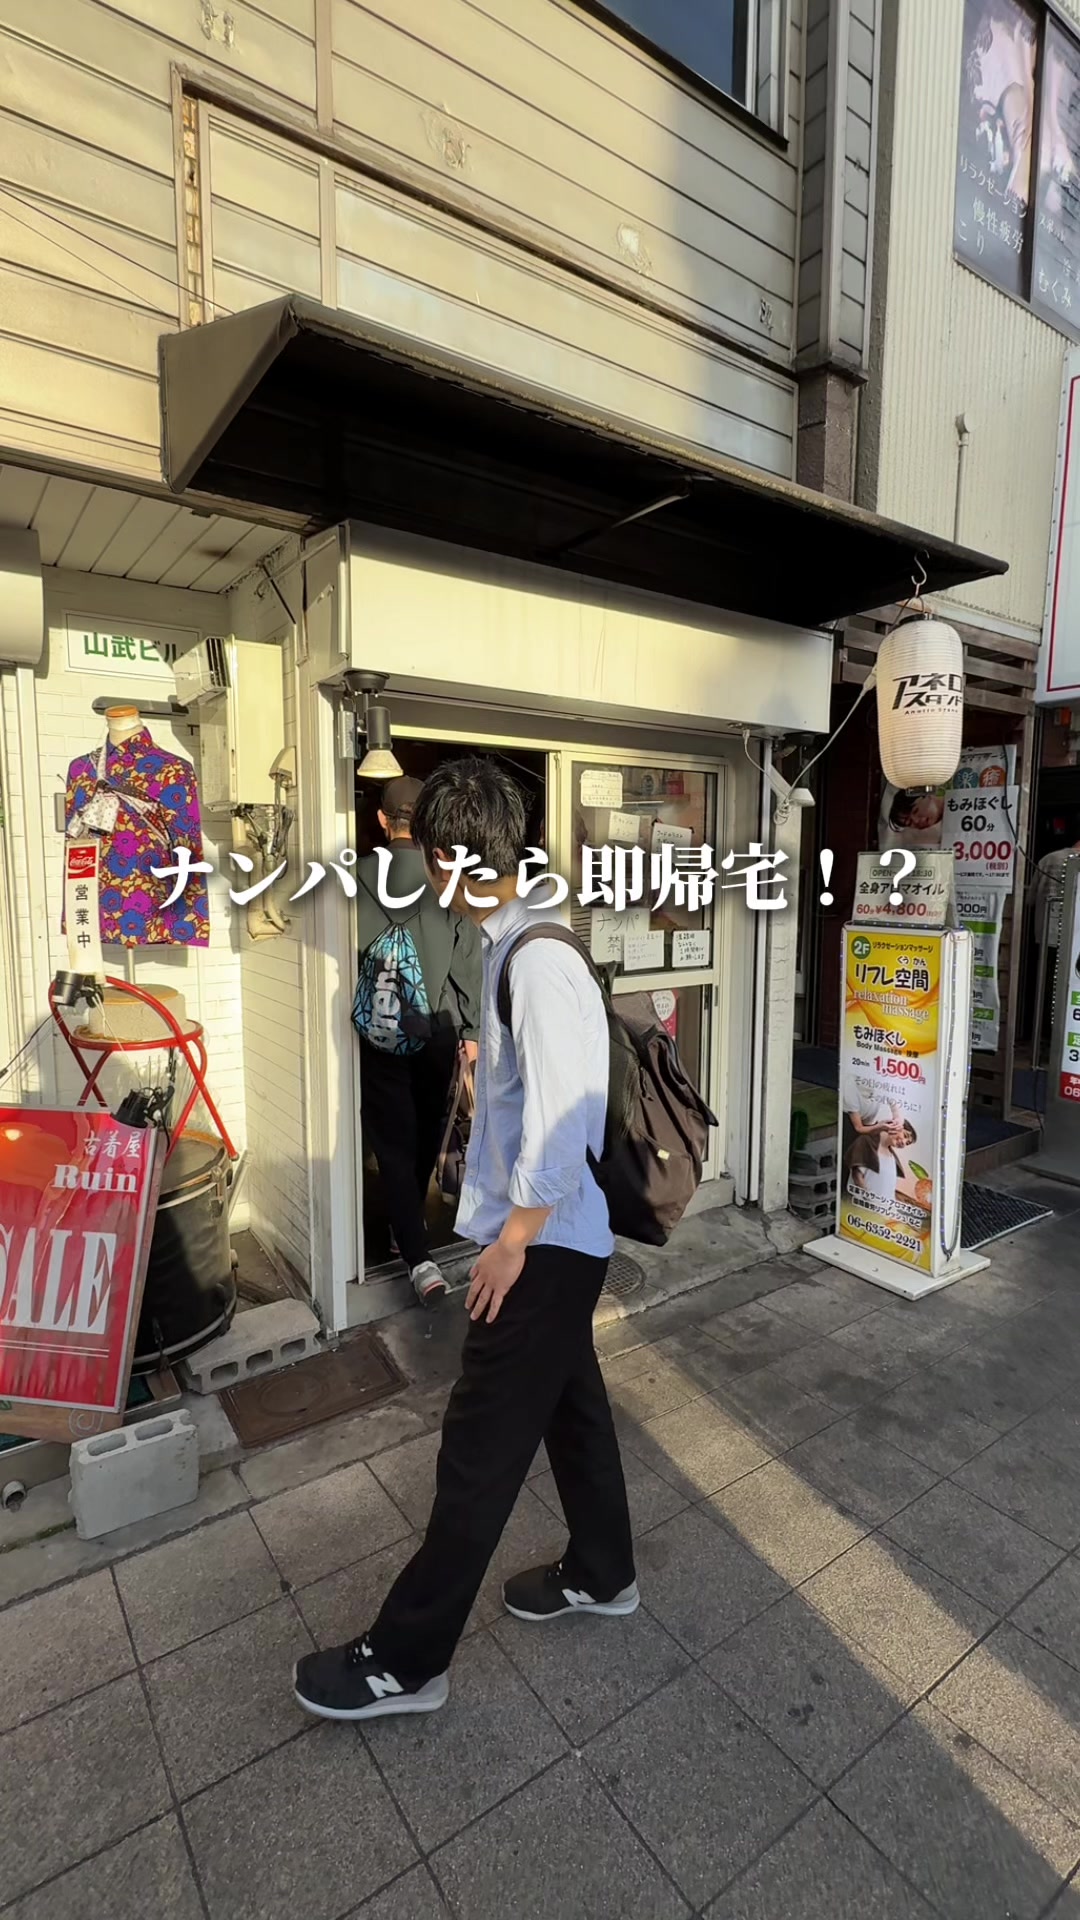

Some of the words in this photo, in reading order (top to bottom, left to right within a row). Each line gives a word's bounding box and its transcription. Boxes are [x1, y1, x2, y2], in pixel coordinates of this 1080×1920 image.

[960, 154, 1027, 218] リラクゼーション
[973, 197, 1024, 253] 慢性疲労
[1039, 267, 1071, 308] むくみ
[84, 632, 184, 663] 山武ビル
[947, 796, 1013, 812] もみほぐし
[75, 884, 91, 949] 営業中
[597, 914, 639, 932] ナンパ
[854, 941, 870, 955] 2F
[873, 942, 934, 953] リラクゼーションマッサージ
[856, 963, 929, 992] リフレ空間
[854, 987, 907, 1006] relaxation
[883, 1003, 929, 1024] massage
[853, 1025, 906, 1046] もみほぐし
[855, 1076, 906, 1095] その日の疲れは
[83, 1130, 141, 1158] 古着屋
[52, 1164, 138, 1193] Ruin
[847, 1214, 921, 1252] 06-6352-2221
